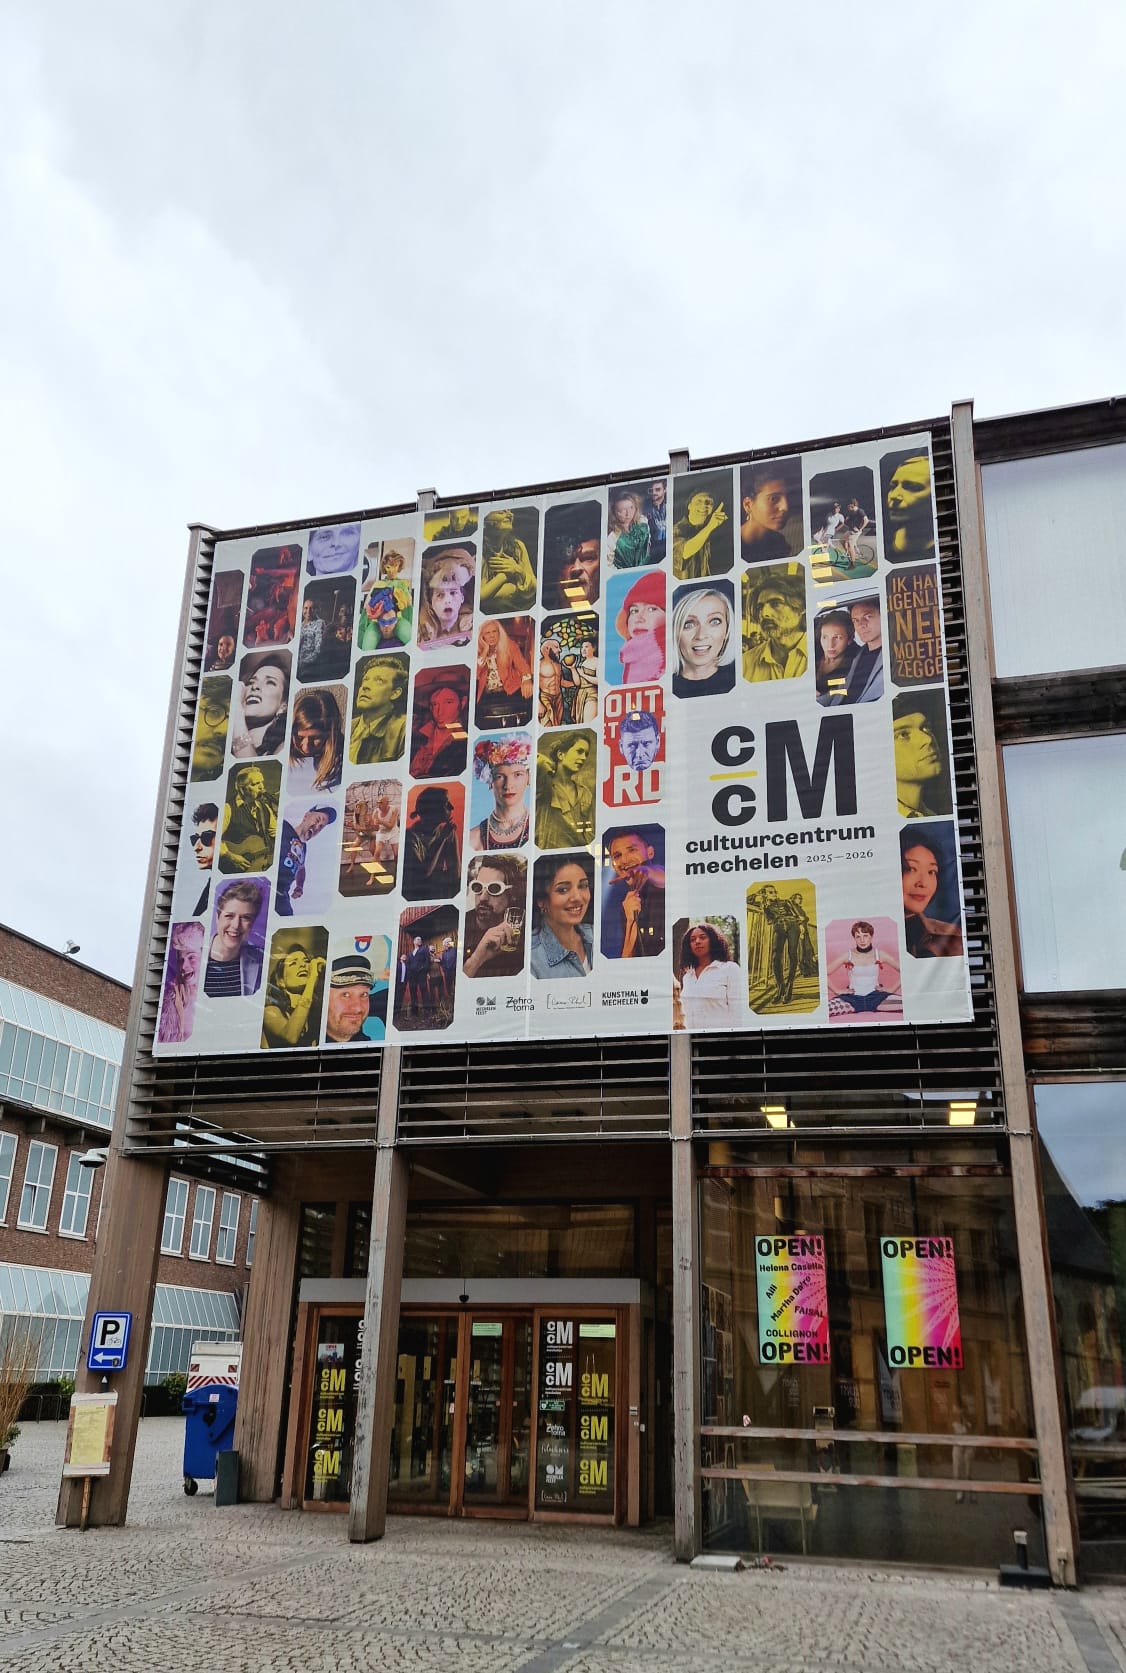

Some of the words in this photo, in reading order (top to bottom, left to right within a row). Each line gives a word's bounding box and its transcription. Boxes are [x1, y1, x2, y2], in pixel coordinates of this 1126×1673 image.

[892, 577, 907, 593] IK
[605, 689, 660, 718] OUT
[685, 825, 876, 853] cultuurcentrum
[685, 854, 799, 876] mechelen
[602, 990, 638, 999] KUNSTHAL
[602, 998, 639, 1007] MECHELEN
[757, 1238, 824, 1257] OPEN!
[882, 1239, 954, 1259] OPEN!
[759, 1264, 790, 1273] Helena
[770, 1293, 796, 1323] Martha
[794, 1305, 824, 1319] FAISAL
[100, 1320, 120, 1345] P
[766, 1328, 819, 1339] COLLIGNON
[761, 1341, 829, 1361] OPEN!
[890, 1346, 960, 1366] OPEN!
